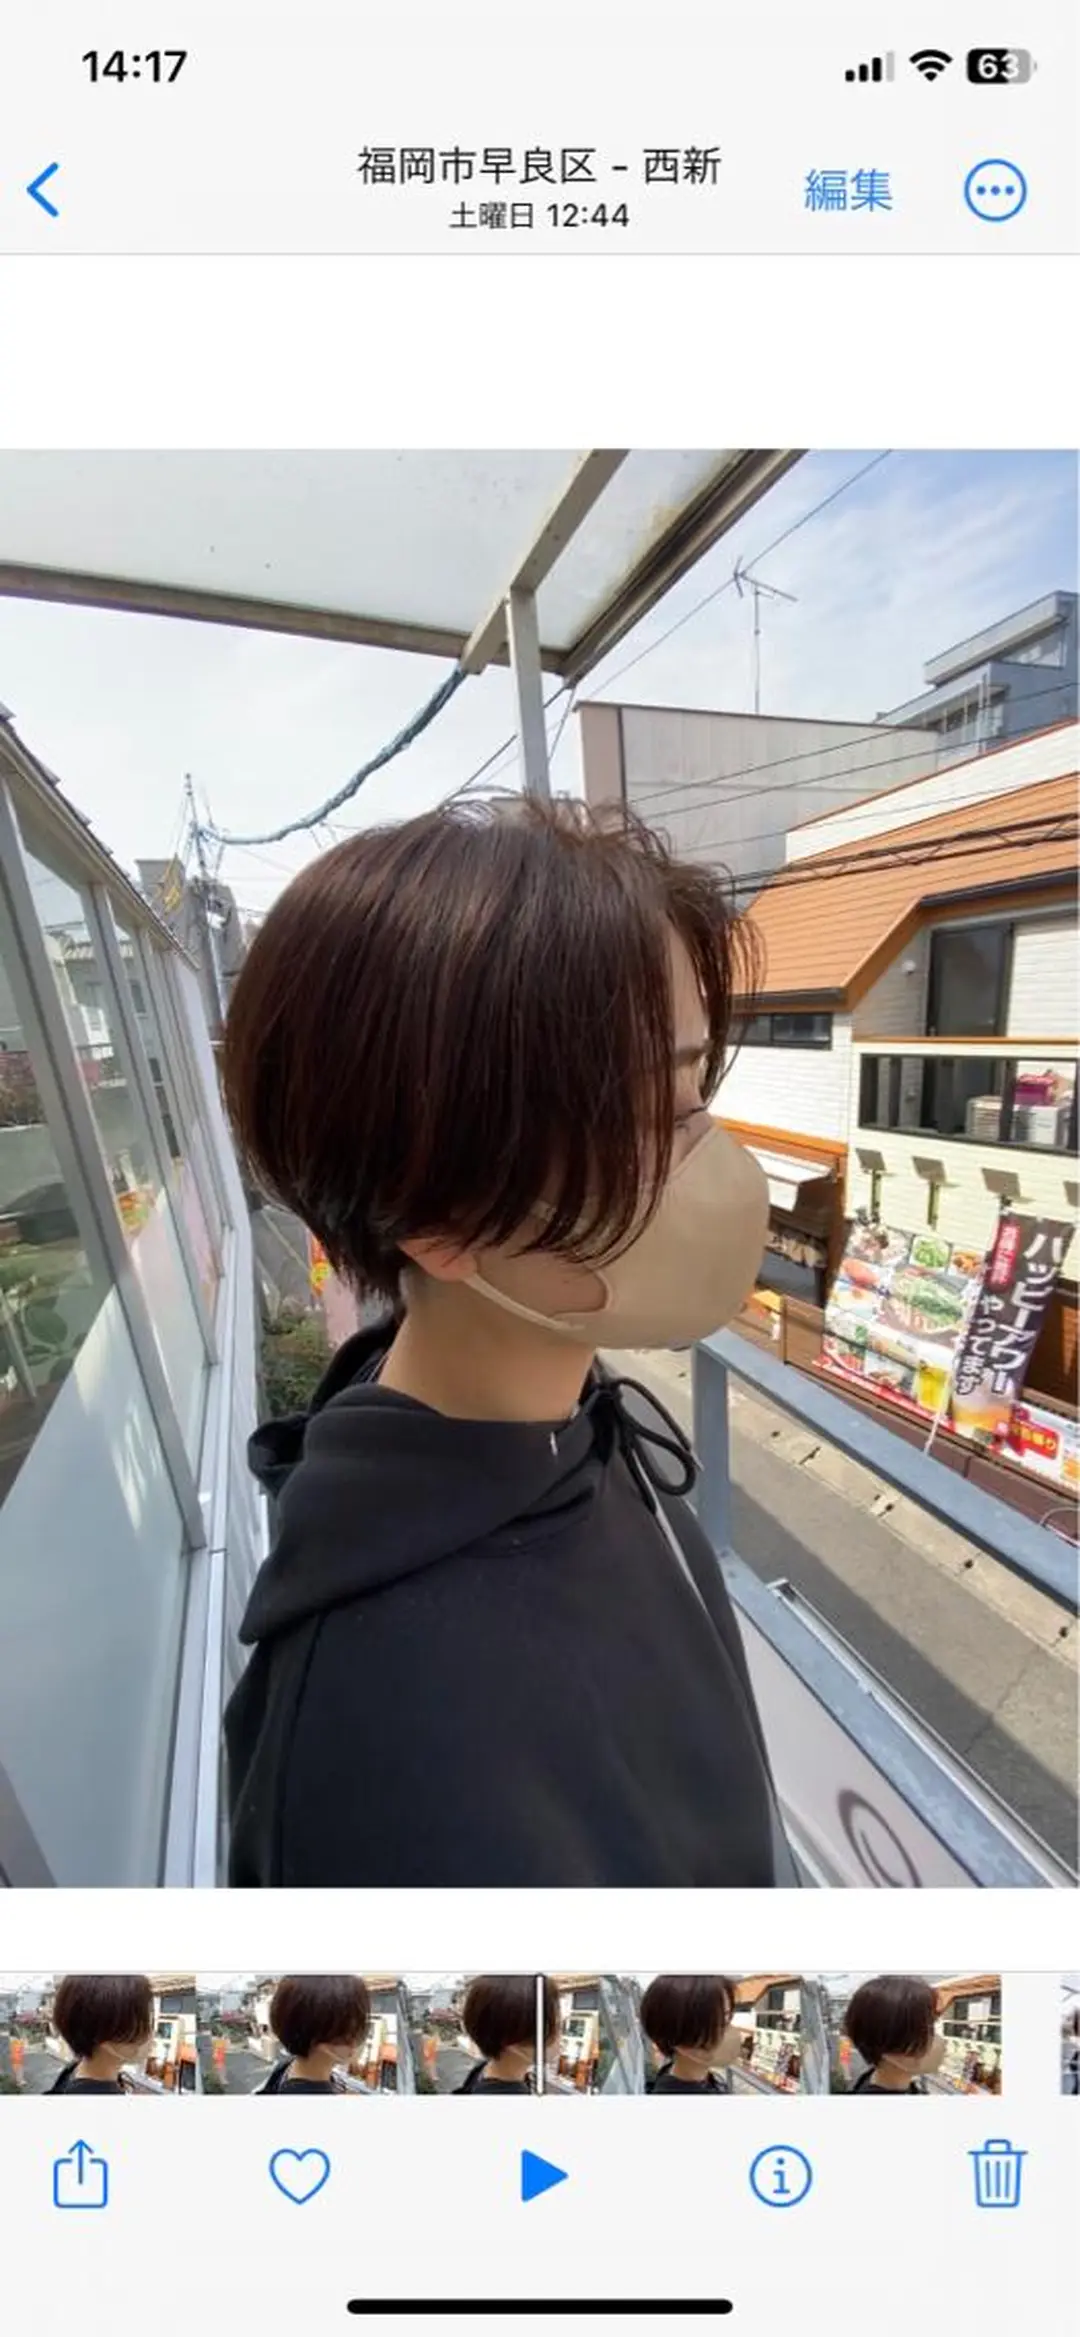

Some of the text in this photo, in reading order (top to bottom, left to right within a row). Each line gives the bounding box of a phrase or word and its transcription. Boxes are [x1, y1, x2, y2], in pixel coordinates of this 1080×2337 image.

[82, 50, 188, 83] 14:17
[979, 53, 1019, 79] 63
[357, 146, 597, 185] 福岡市早良区
[643, 147, 722, 185] 西新
[804, 168, 893, 213] 編集
[450, 201, 630, 230] 土曜日 12:44
[993, 1232, 1063, 1394] ハッピーアワー
[957, 1294, 1005, 1395] やってます
